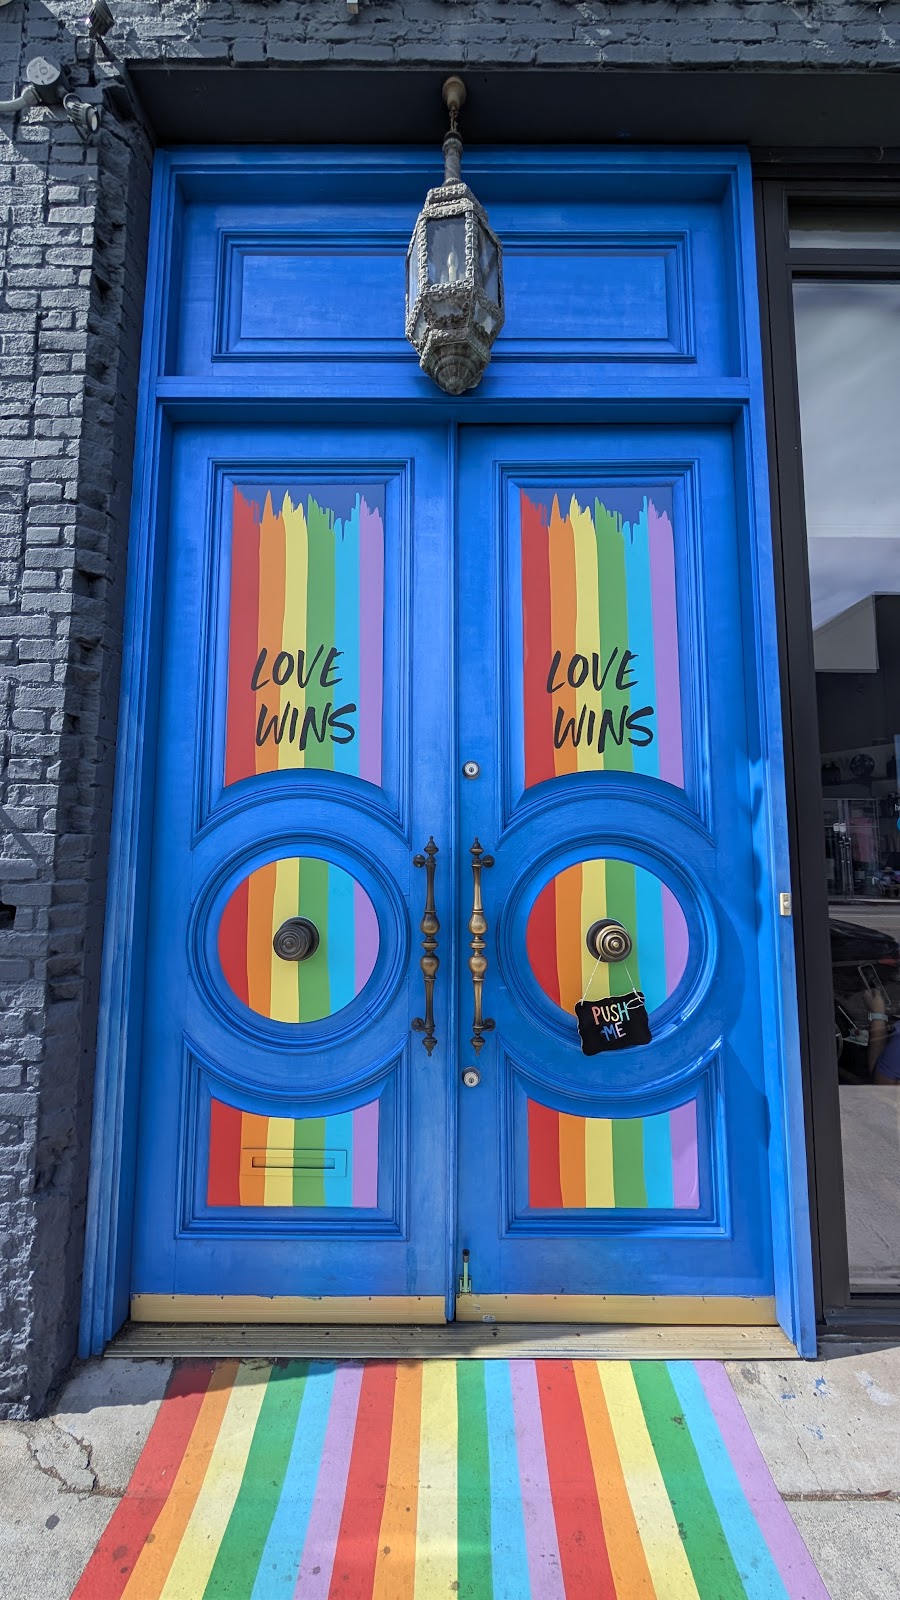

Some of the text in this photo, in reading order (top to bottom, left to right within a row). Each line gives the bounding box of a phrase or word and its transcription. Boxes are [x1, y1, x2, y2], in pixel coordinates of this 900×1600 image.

[250, 643, 345, 692] LOVE
[546, 646, 640, 694] LOVE
[255, 700, 357, 752] WINS
[553, 703, 655, 755] WINS
[591, 1002, 630, 1025] PUSH
[601, 1021, 626, 1041] ME
